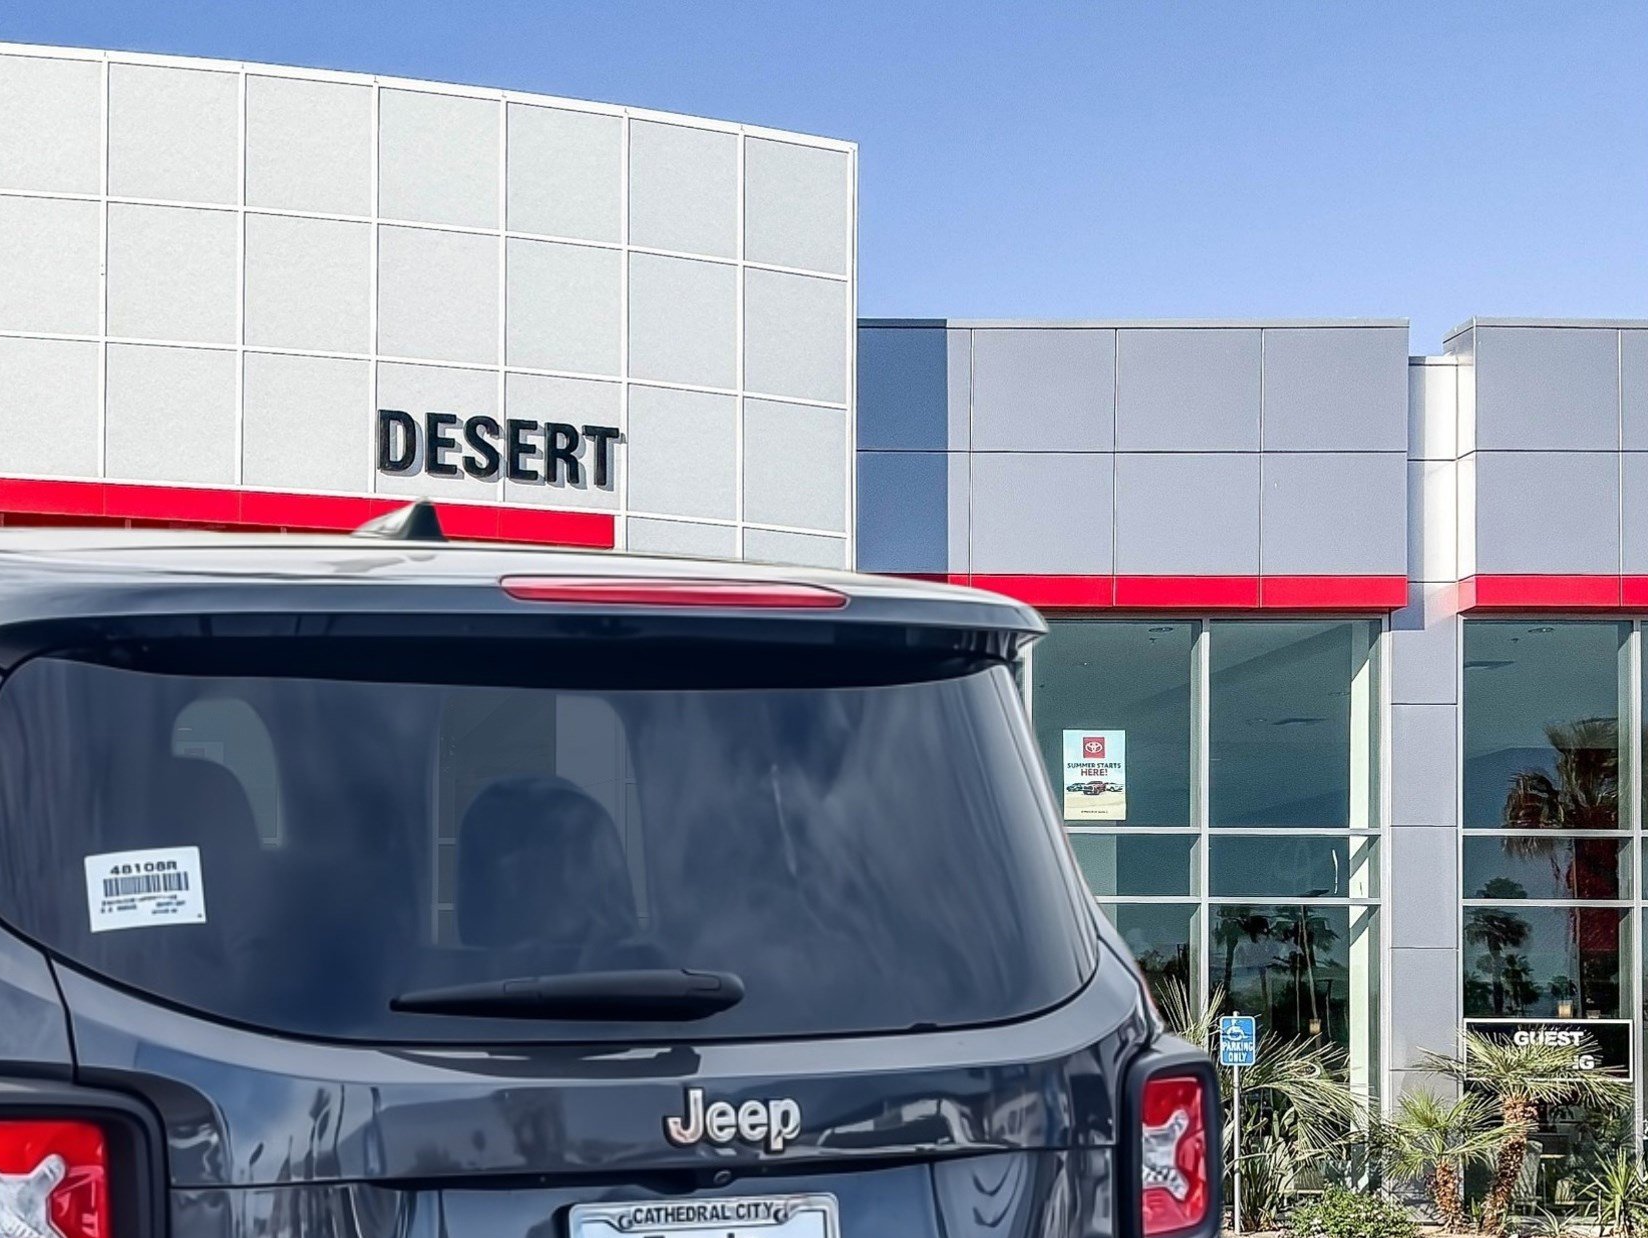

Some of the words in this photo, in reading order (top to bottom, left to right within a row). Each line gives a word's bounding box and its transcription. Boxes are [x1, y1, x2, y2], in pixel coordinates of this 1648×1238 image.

[377, 409, 620, 486] DESERT
[1080, 768, 1108, 776] HERE!
[1222, 1041, 1254, 1051] PARKING
[1513, 1031, 1584, 1046] GUEST
[1228, 1051, 1248, 1062] ONLY
[666, 1087, 801, 1151] Jeep
[632, 1203, 730, 1225] CATHEDRAL
[735, 1202, 775, 1220] CITY
